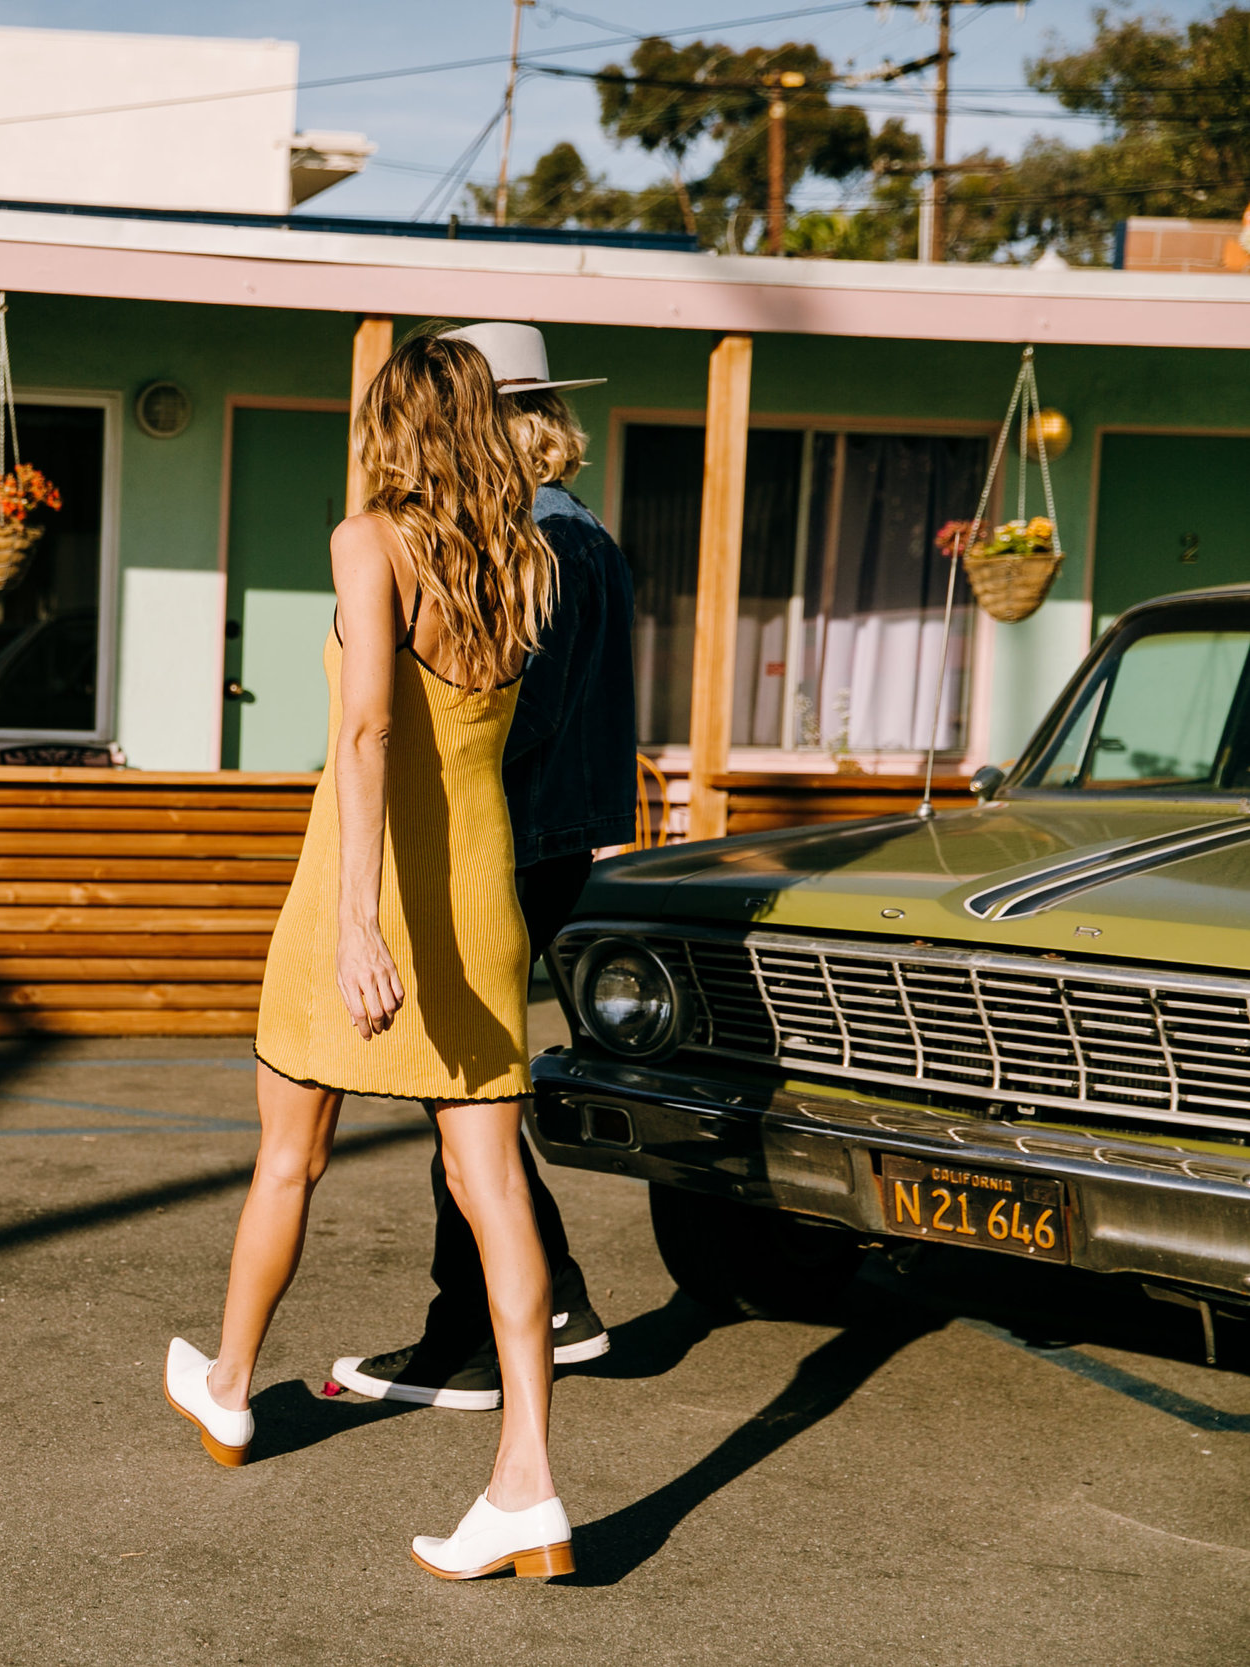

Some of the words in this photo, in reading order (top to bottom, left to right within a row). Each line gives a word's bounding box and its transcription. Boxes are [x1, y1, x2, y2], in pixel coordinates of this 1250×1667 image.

[1180, 532, 1199, 565] 2
[931, 1167, 1012, 1192] CALIFORNIA
[987, 1199, 1055, 1249] 646
